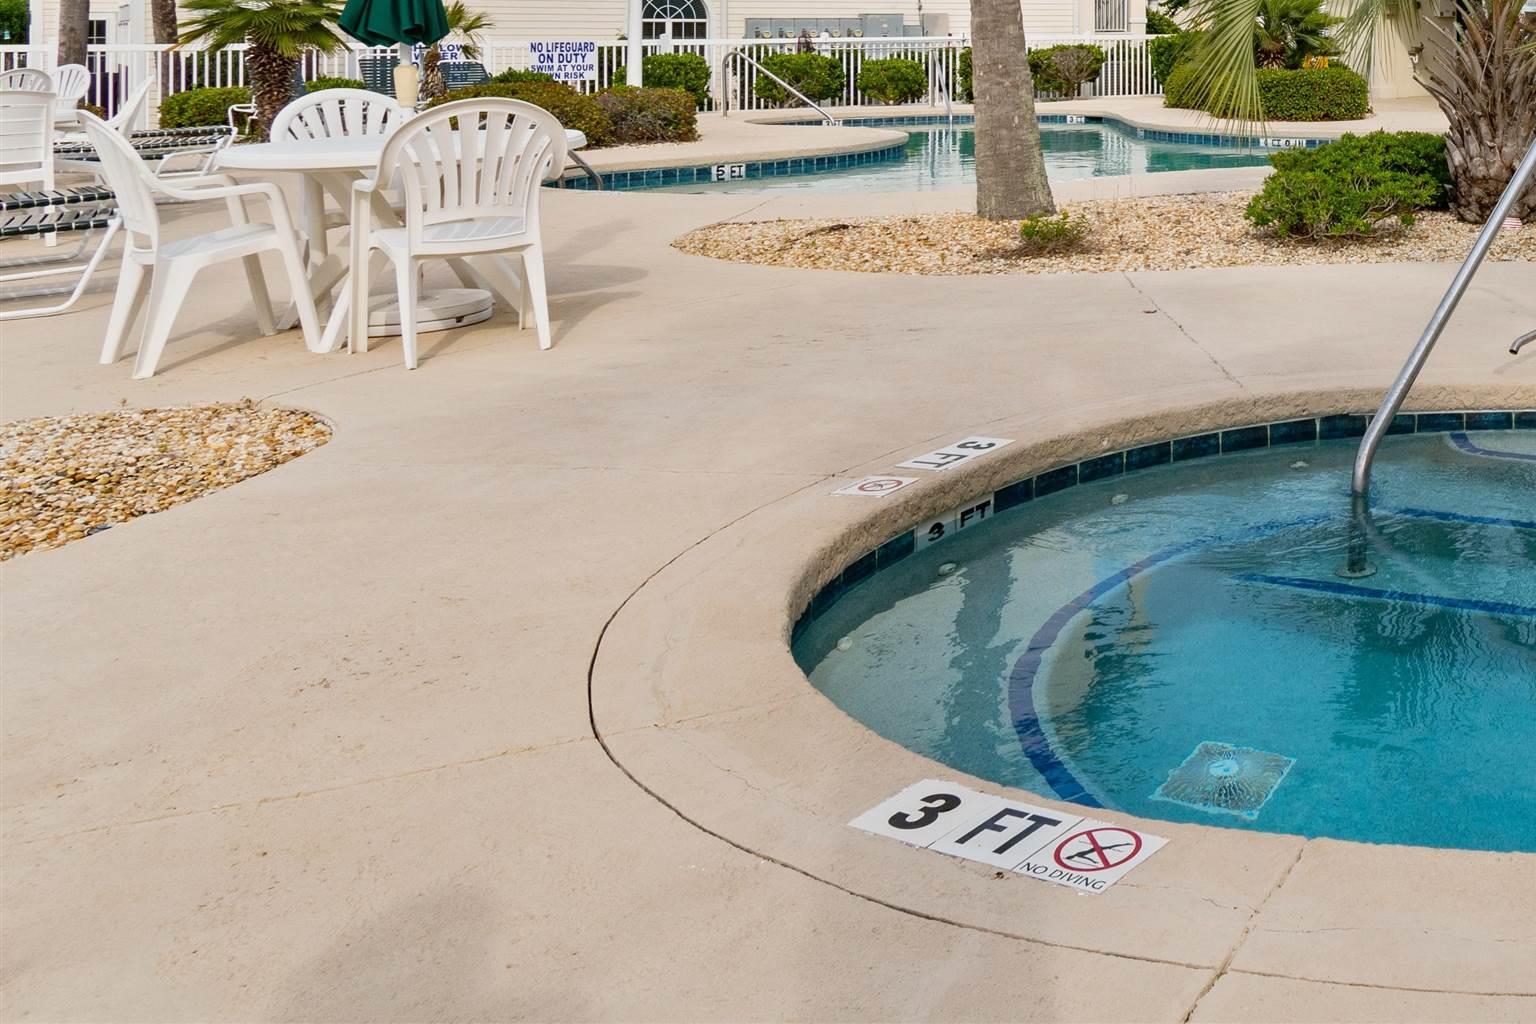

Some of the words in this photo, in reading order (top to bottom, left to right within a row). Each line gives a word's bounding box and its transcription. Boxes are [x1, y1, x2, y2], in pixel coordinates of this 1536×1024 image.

[530, 42, 543, 53] NO
[546, 41, 595, 53] LIFEGUARD
[538, 53, 554, 64] ON
[558, 53, 587, 64] DUTY
[531, 64, 555, 73] SWIM
[557, 64, 568, 72] AT
[571, 64, 594, 72] YOUR
[564, 72, 585, 80] RISK
[956, 440, 996, 451] 3
[912, 452, 969, 468] FT
[959, 500, 991, 529] FT
[888, 793, 962, 830] 3
[954, 807, 1063, 855] FT
[1020, 862, 1049, 875] NO
[1048, 869, 1107, 890] DIVING
